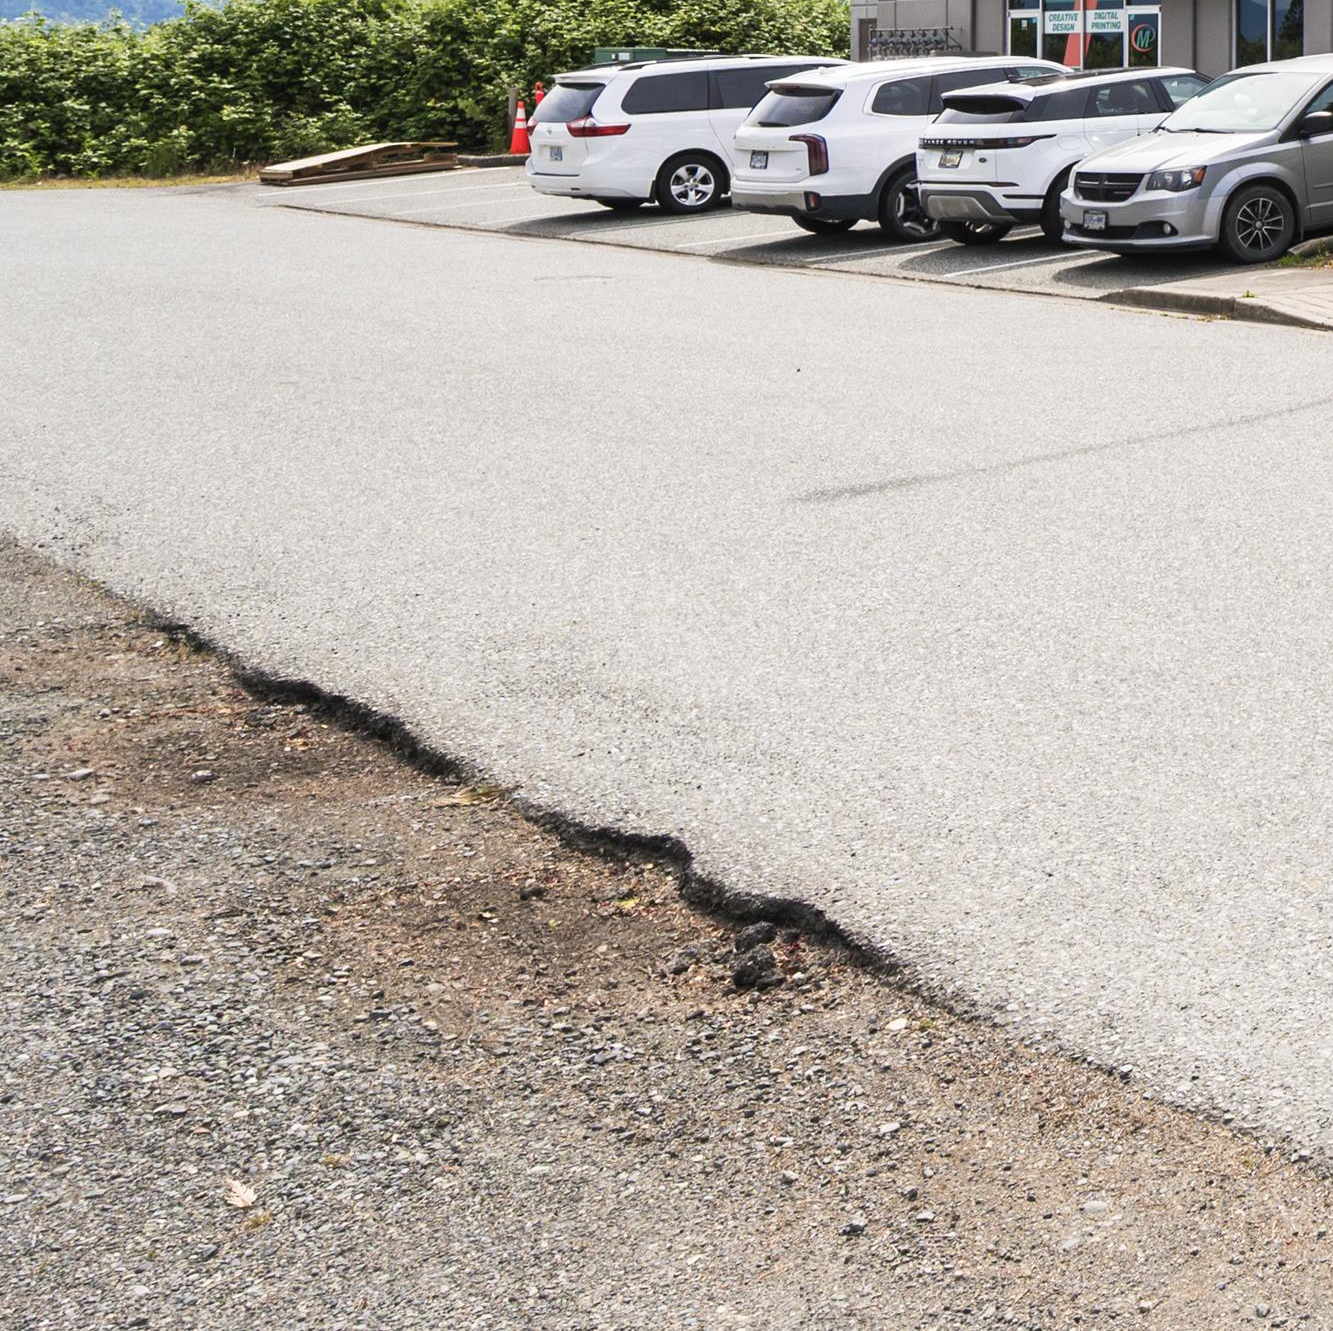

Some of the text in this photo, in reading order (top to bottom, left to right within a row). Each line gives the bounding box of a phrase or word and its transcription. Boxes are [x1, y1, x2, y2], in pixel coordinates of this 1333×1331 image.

[1049, 13, 1078, 22] CREATIVE
[1094, 11, 1118, 20] DIGITAL
[1052, 23, 1075, 32] DESIGN
[1091, 21, 1121, 30] PRINTING
